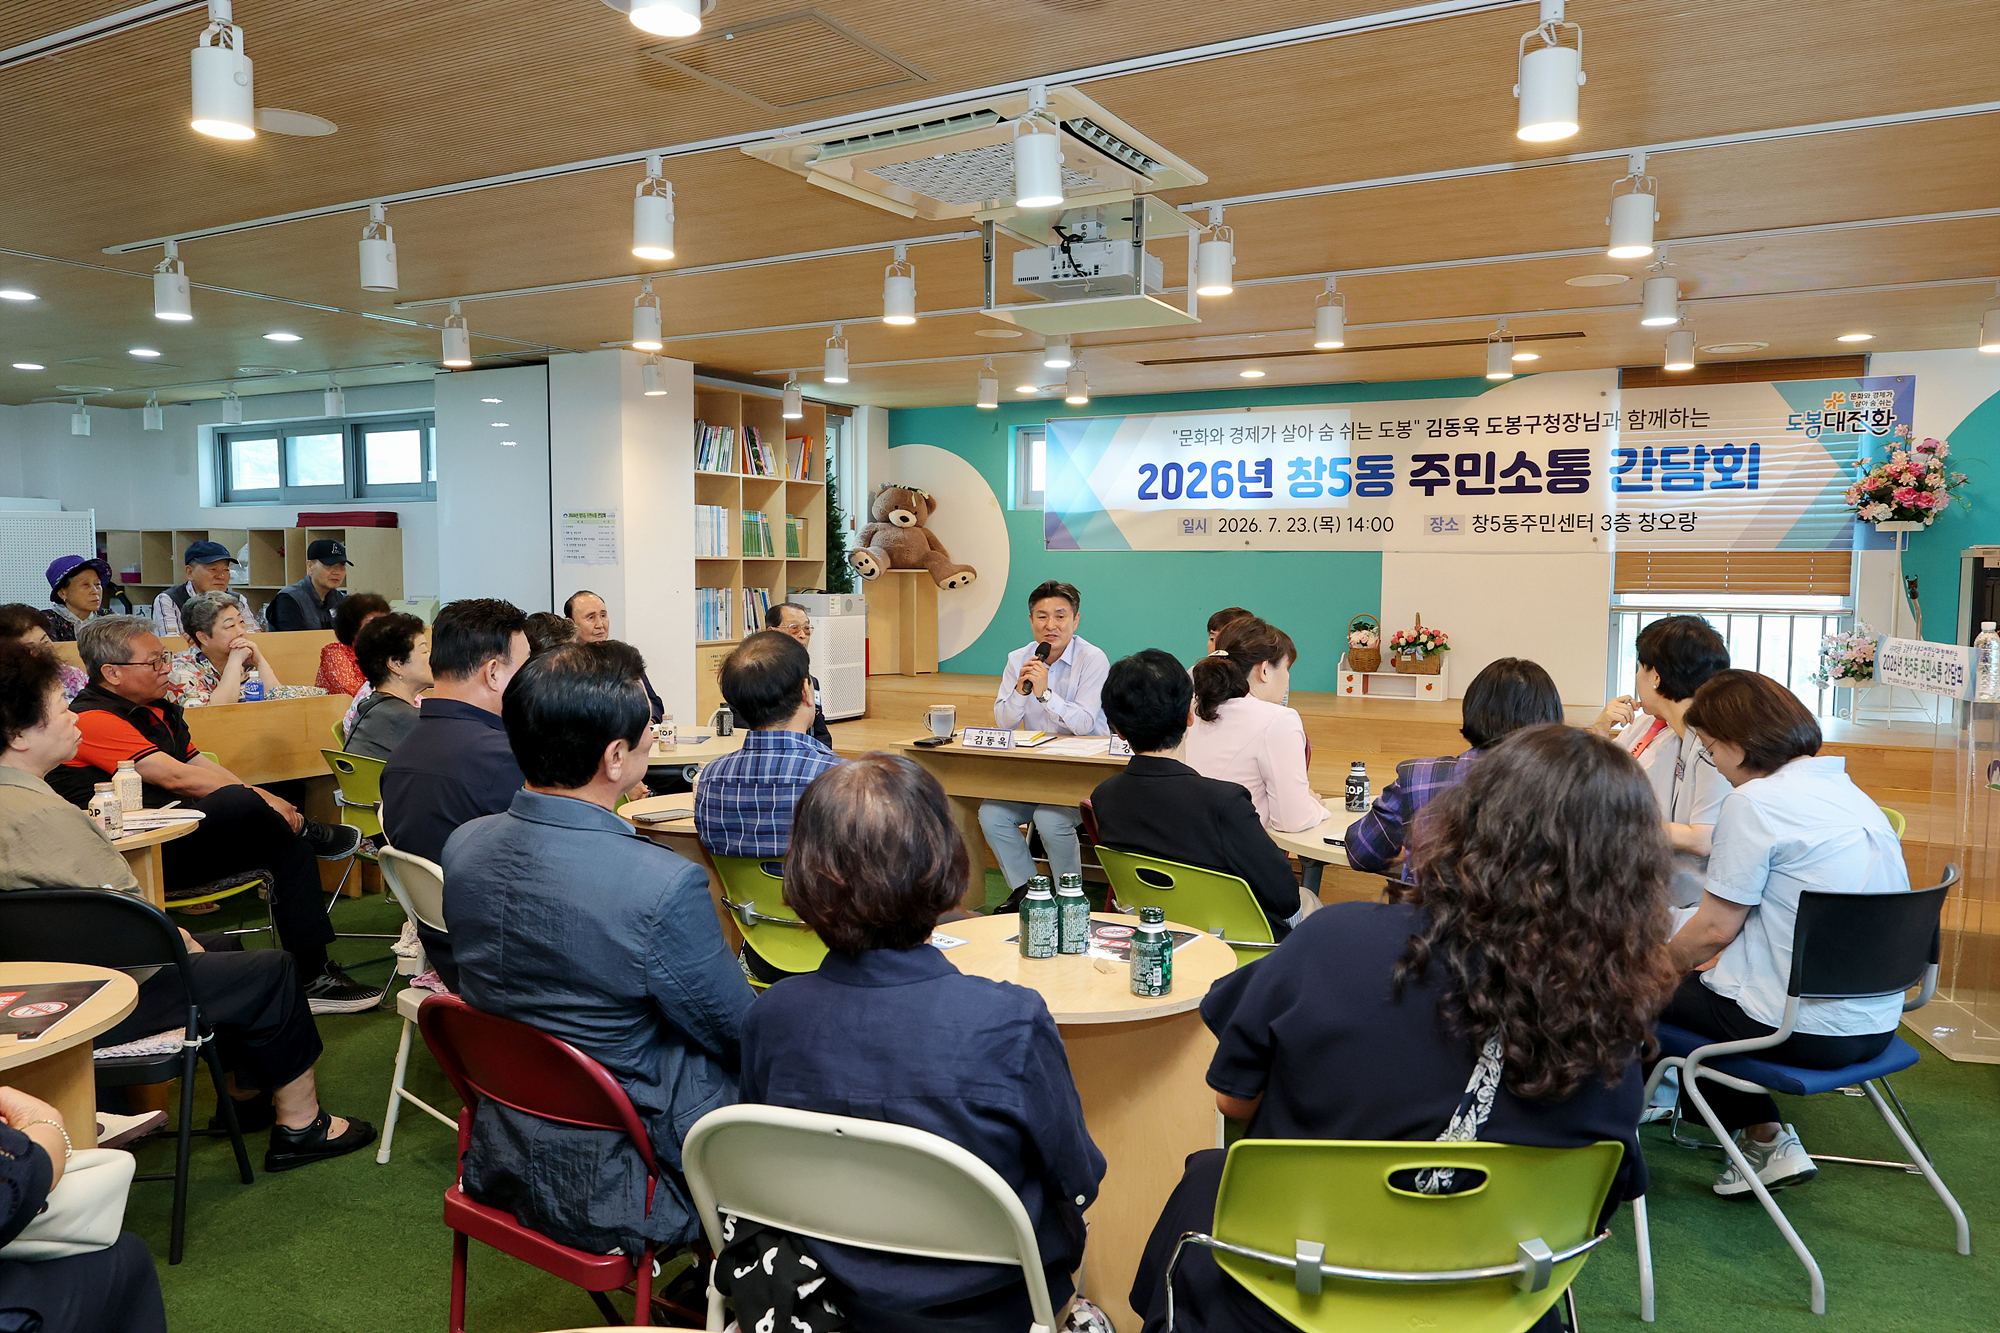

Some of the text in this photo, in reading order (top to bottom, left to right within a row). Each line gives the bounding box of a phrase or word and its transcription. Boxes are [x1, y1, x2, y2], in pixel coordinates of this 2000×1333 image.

[1172, 407, 1711, 447] "문화와 경제가 살아 숨 쉬는 도봉" 김동욱 도봉구청장님과 함께하는
[1137, 442, 1761, 501] 2026년 창5동 주민소통 간담회
[1182, 511, 1698, 534] 일시 2026. 7. 23.(목) 14:00 장소 창5동주민센터 3층 창오랑
[974, 735, 1007, 747] 김동욱
